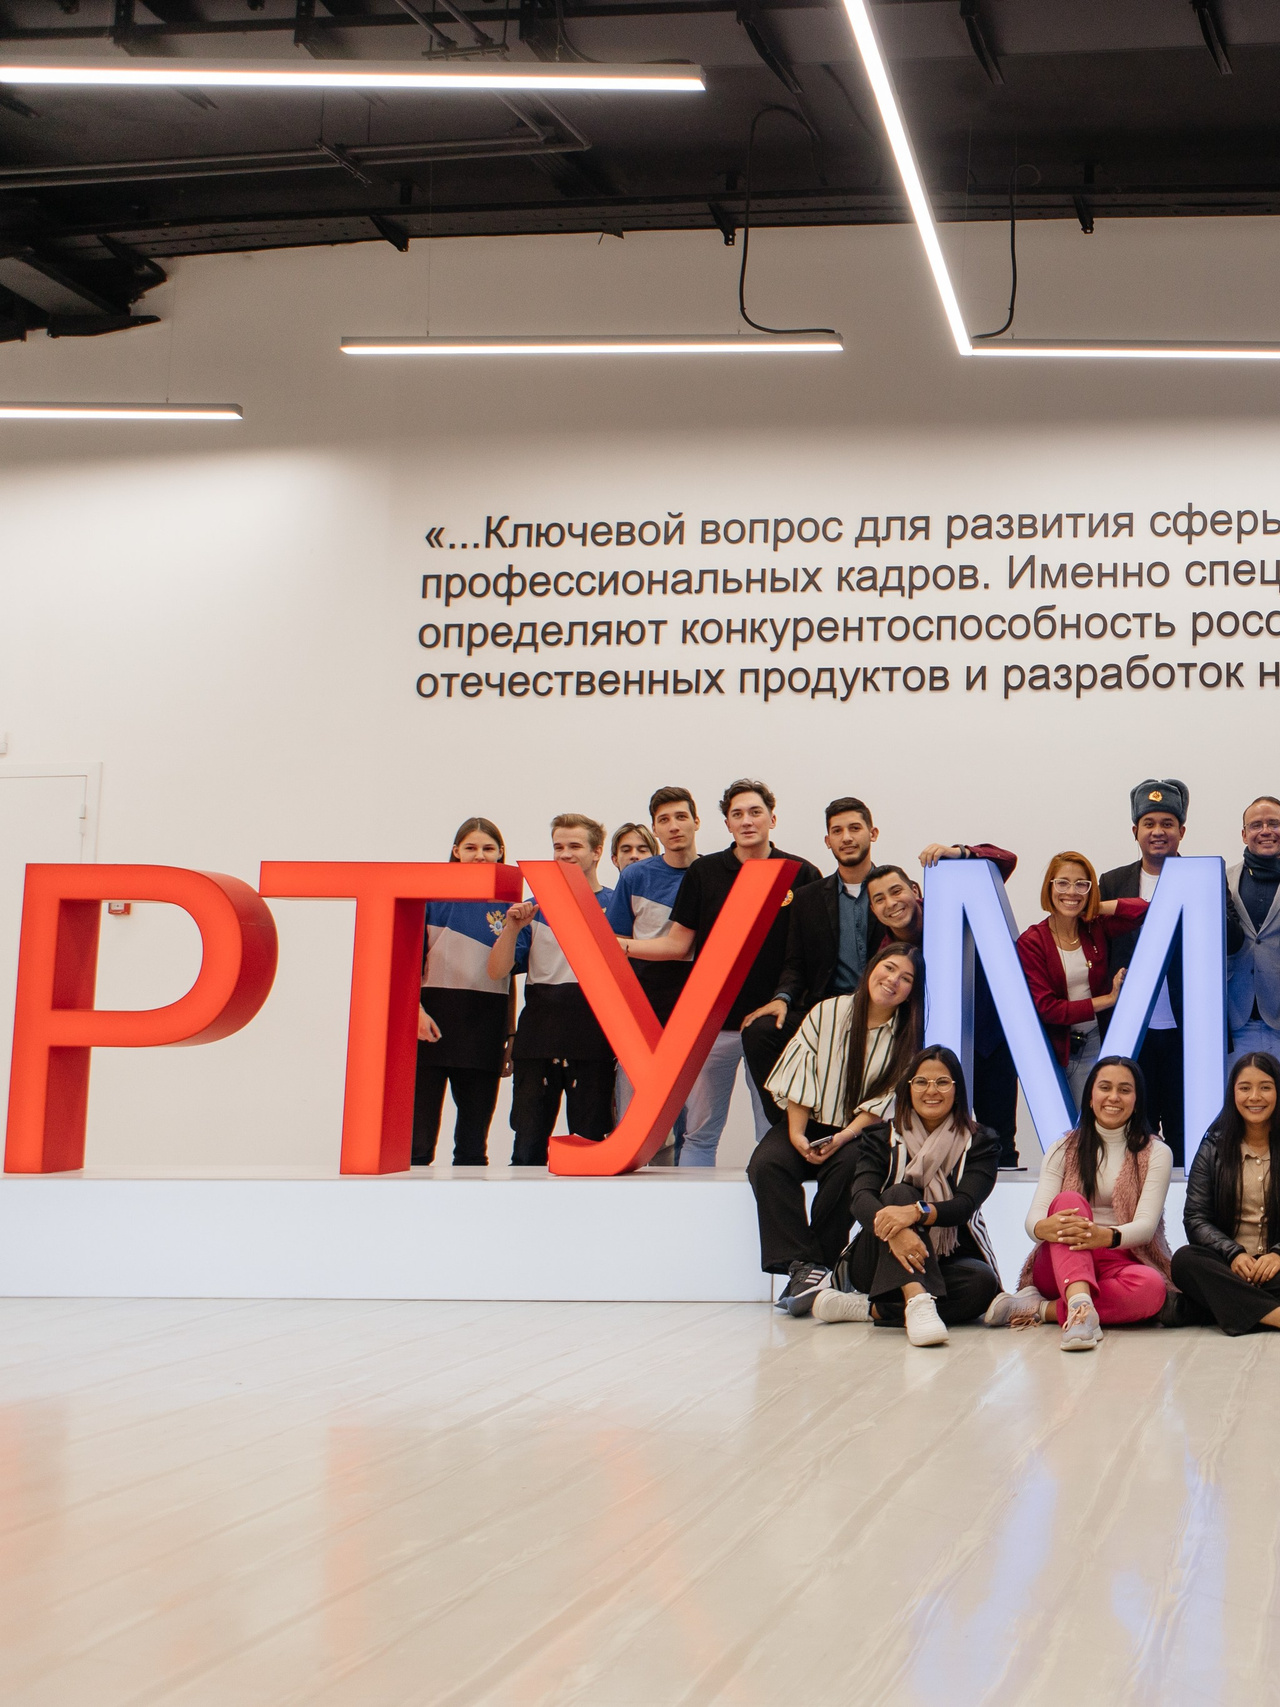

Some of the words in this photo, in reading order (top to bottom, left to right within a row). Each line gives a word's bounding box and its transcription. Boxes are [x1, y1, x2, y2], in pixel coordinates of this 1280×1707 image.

[424, 511, 685, 550] «...Ключевой
[700, 517, 843, 552] вопрос
[854, 515, 930, 548] для
[946, 512, 1134, 549] развития
[421, 564, 823, 608] профессиональных
[837, 564, 990, 600] кадров.
[1008, 554, 1170, 589] Именно
[418, 619, 668, 657] определяют
[681, 604, 1176, 652] конкурентоспособность
[416, 668, 725, 699] отечественных
[739, 665, 950, 703] продуктов
[965, 665, 987, 691] и
[1003, 653, 1245, 700] разработок
[3, 859, 801, 1176] РТУ
